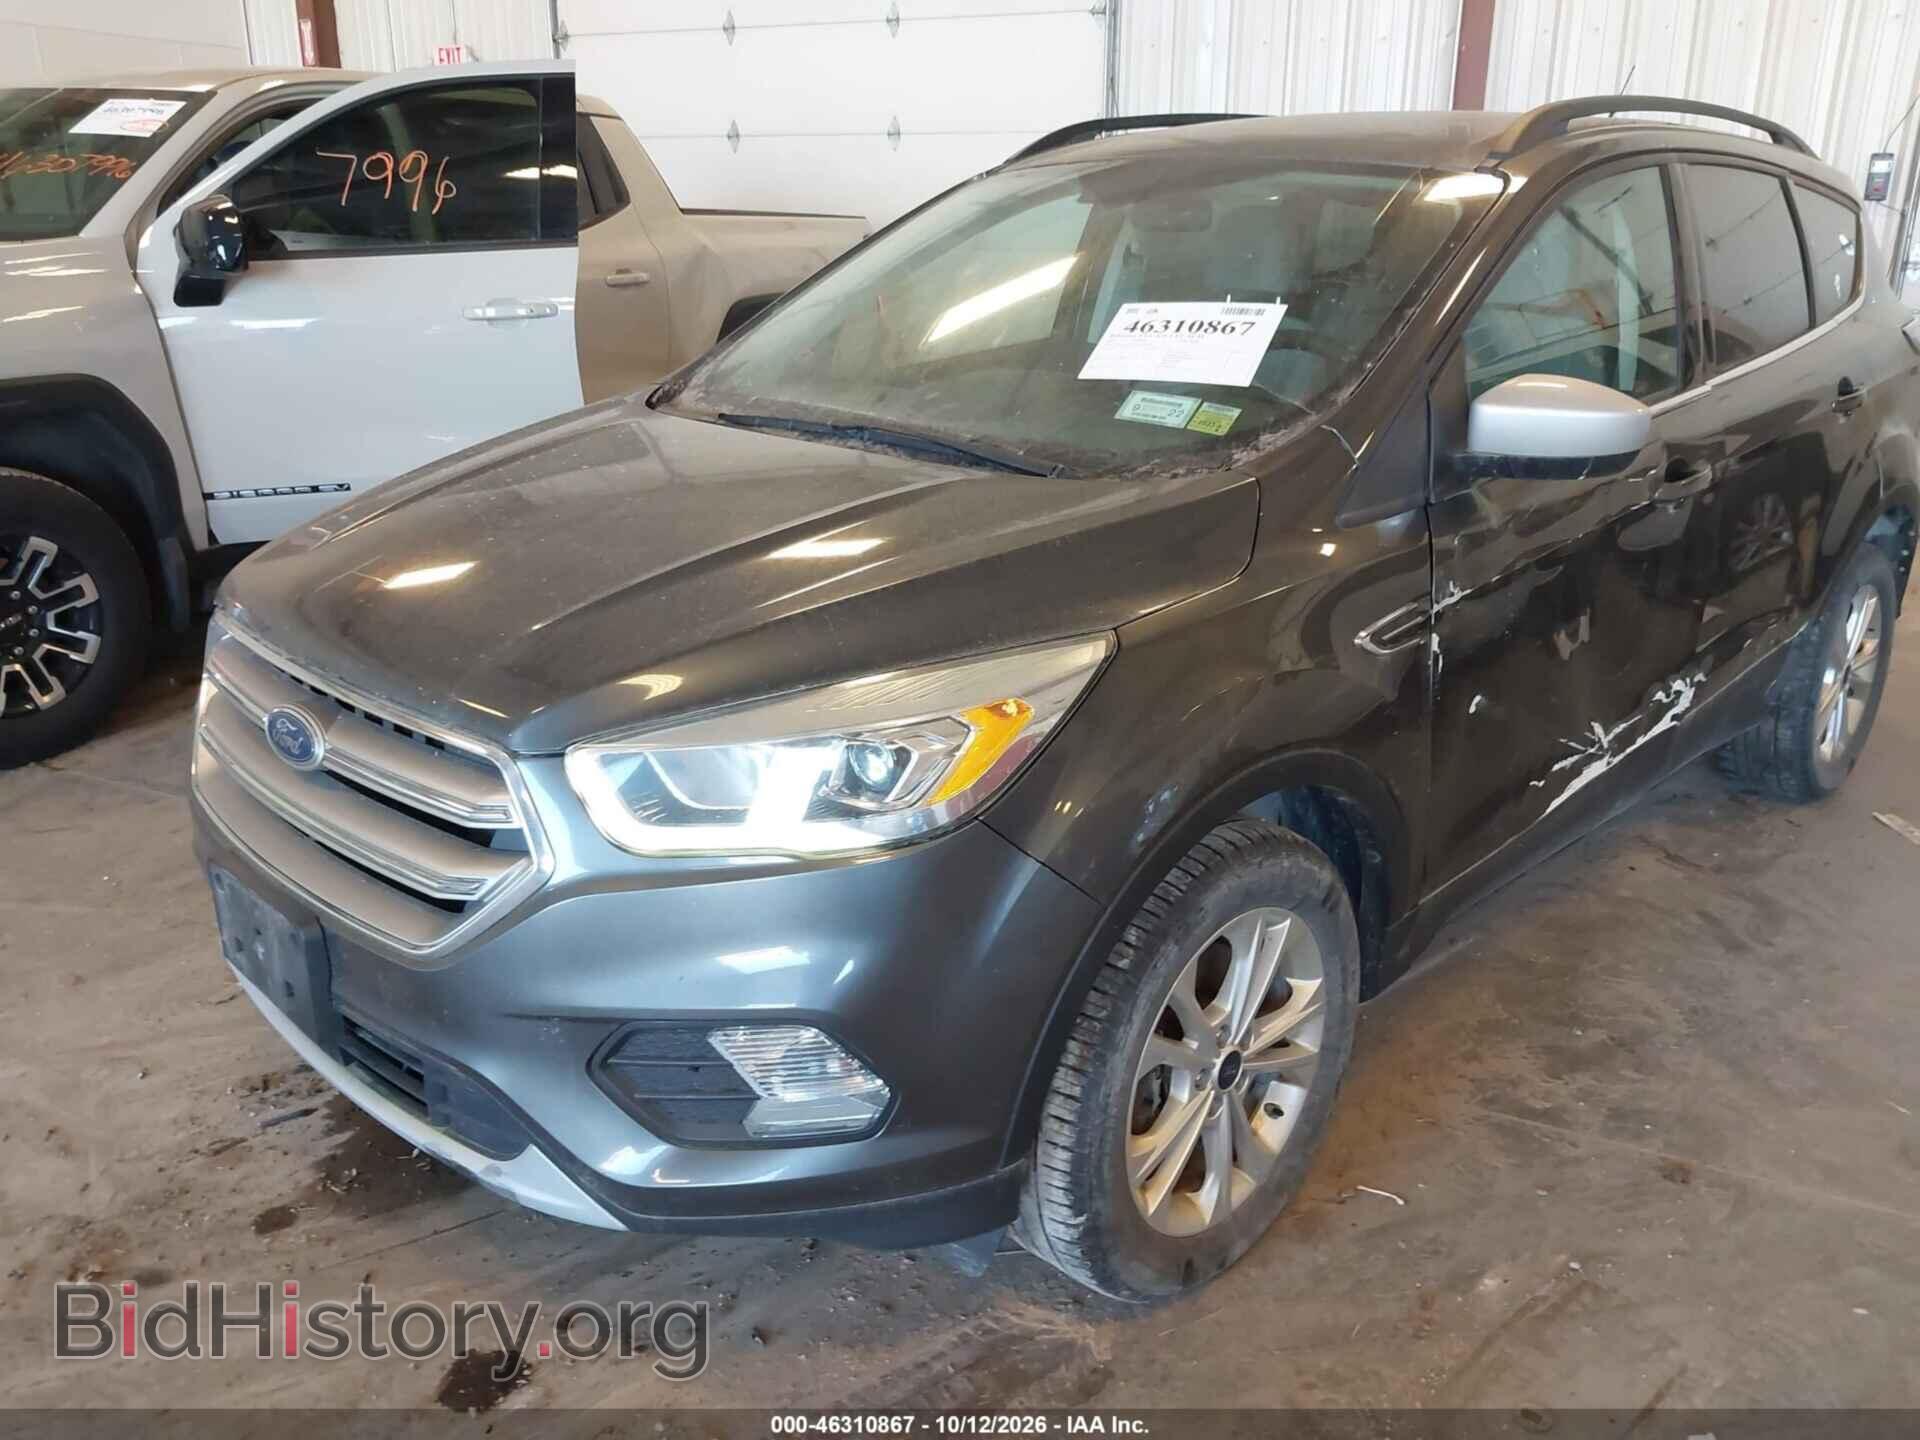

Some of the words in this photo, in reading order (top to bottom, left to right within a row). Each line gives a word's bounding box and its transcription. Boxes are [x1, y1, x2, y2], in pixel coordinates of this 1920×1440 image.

[438, 47, 461, 64] EXIT
[315, 147, 457, 215] 7996
[1124, 319, 1256, 336] 46310867
[272, 718, 304, 754] Ford
